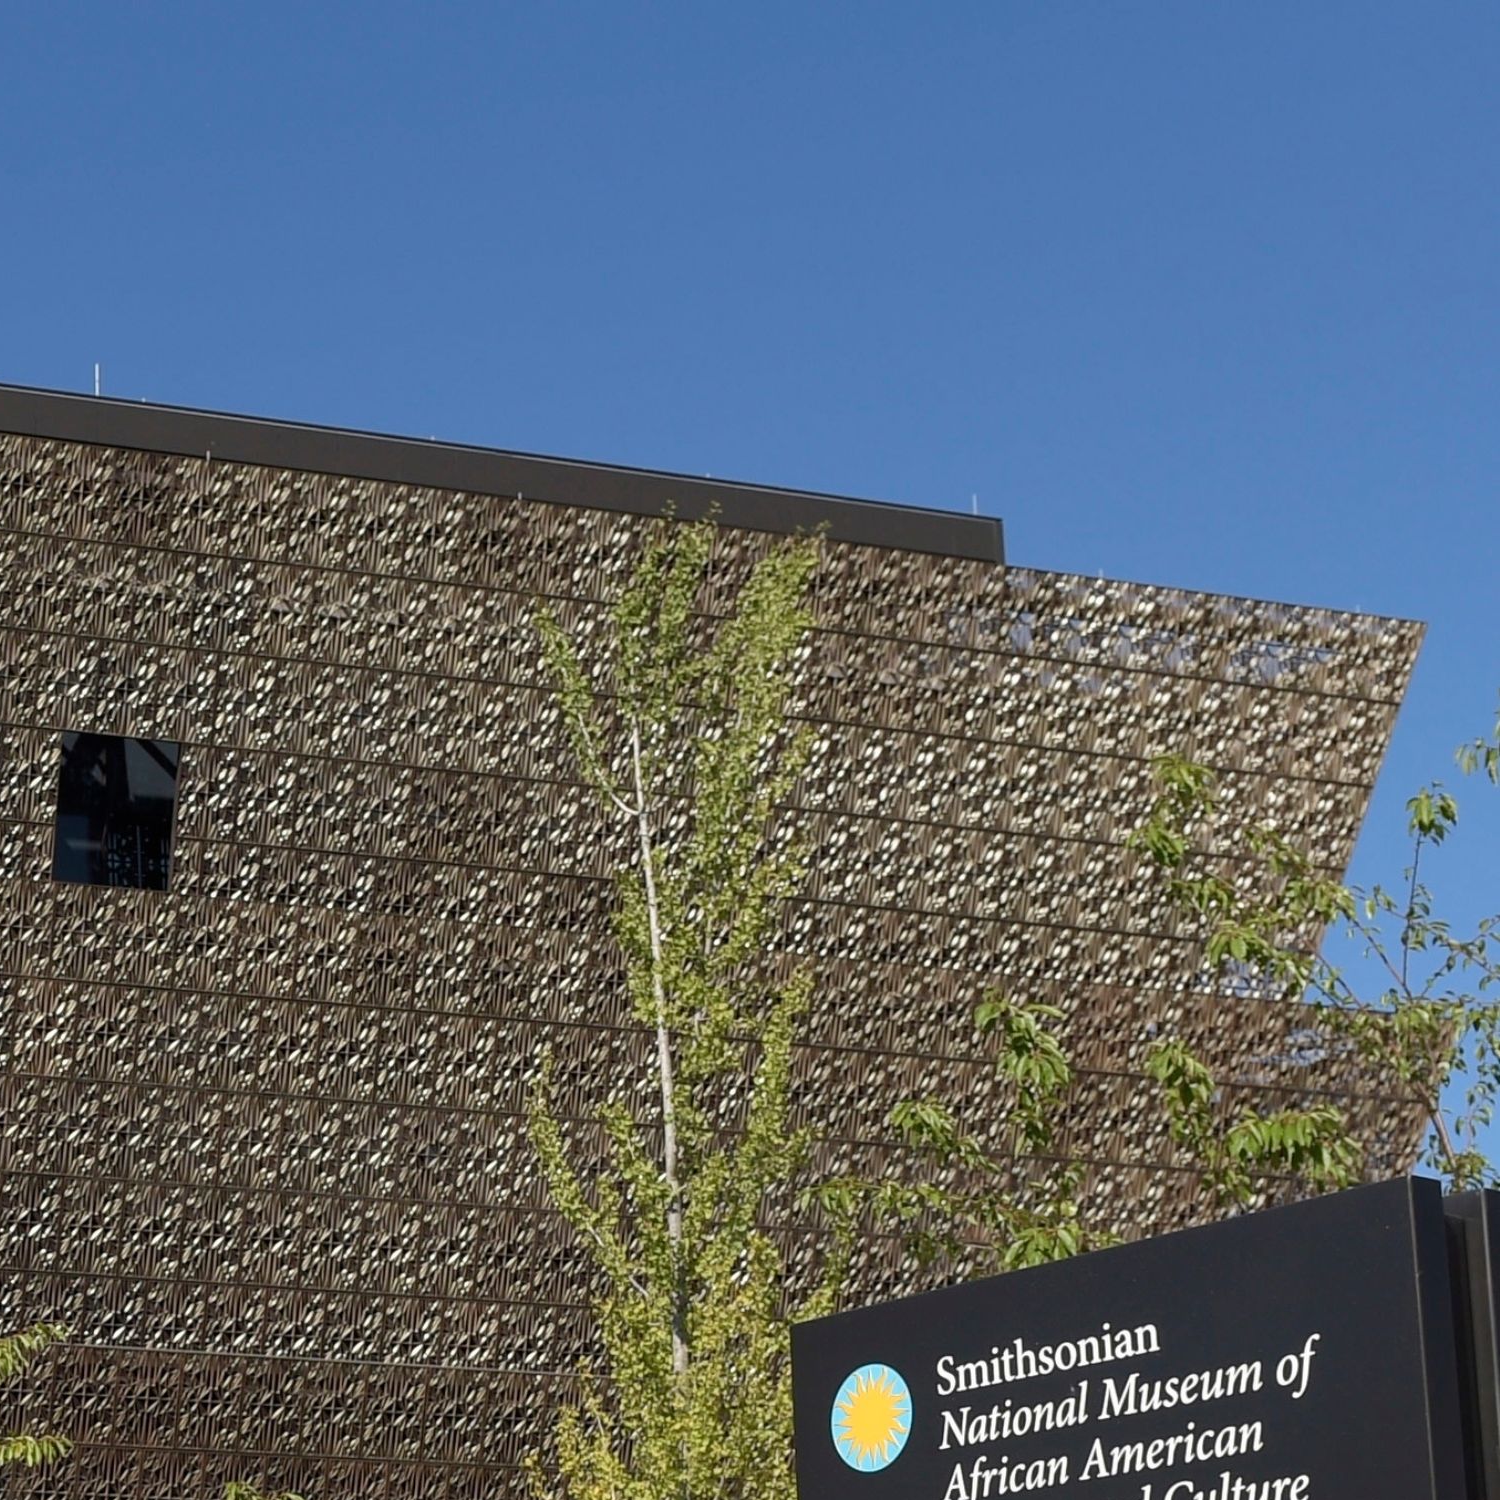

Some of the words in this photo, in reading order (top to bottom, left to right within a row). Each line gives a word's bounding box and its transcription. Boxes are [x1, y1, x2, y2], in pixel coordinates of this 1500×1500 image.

[936, 1322, 1161, 1396] Smithsonian
[938, 1379, 1089, 1450] National
[1097, 1360, 1264, 1420] Museum
[1275, 1333, 1321, 1399] of
[1078, 1421, 1264, 1481] American
